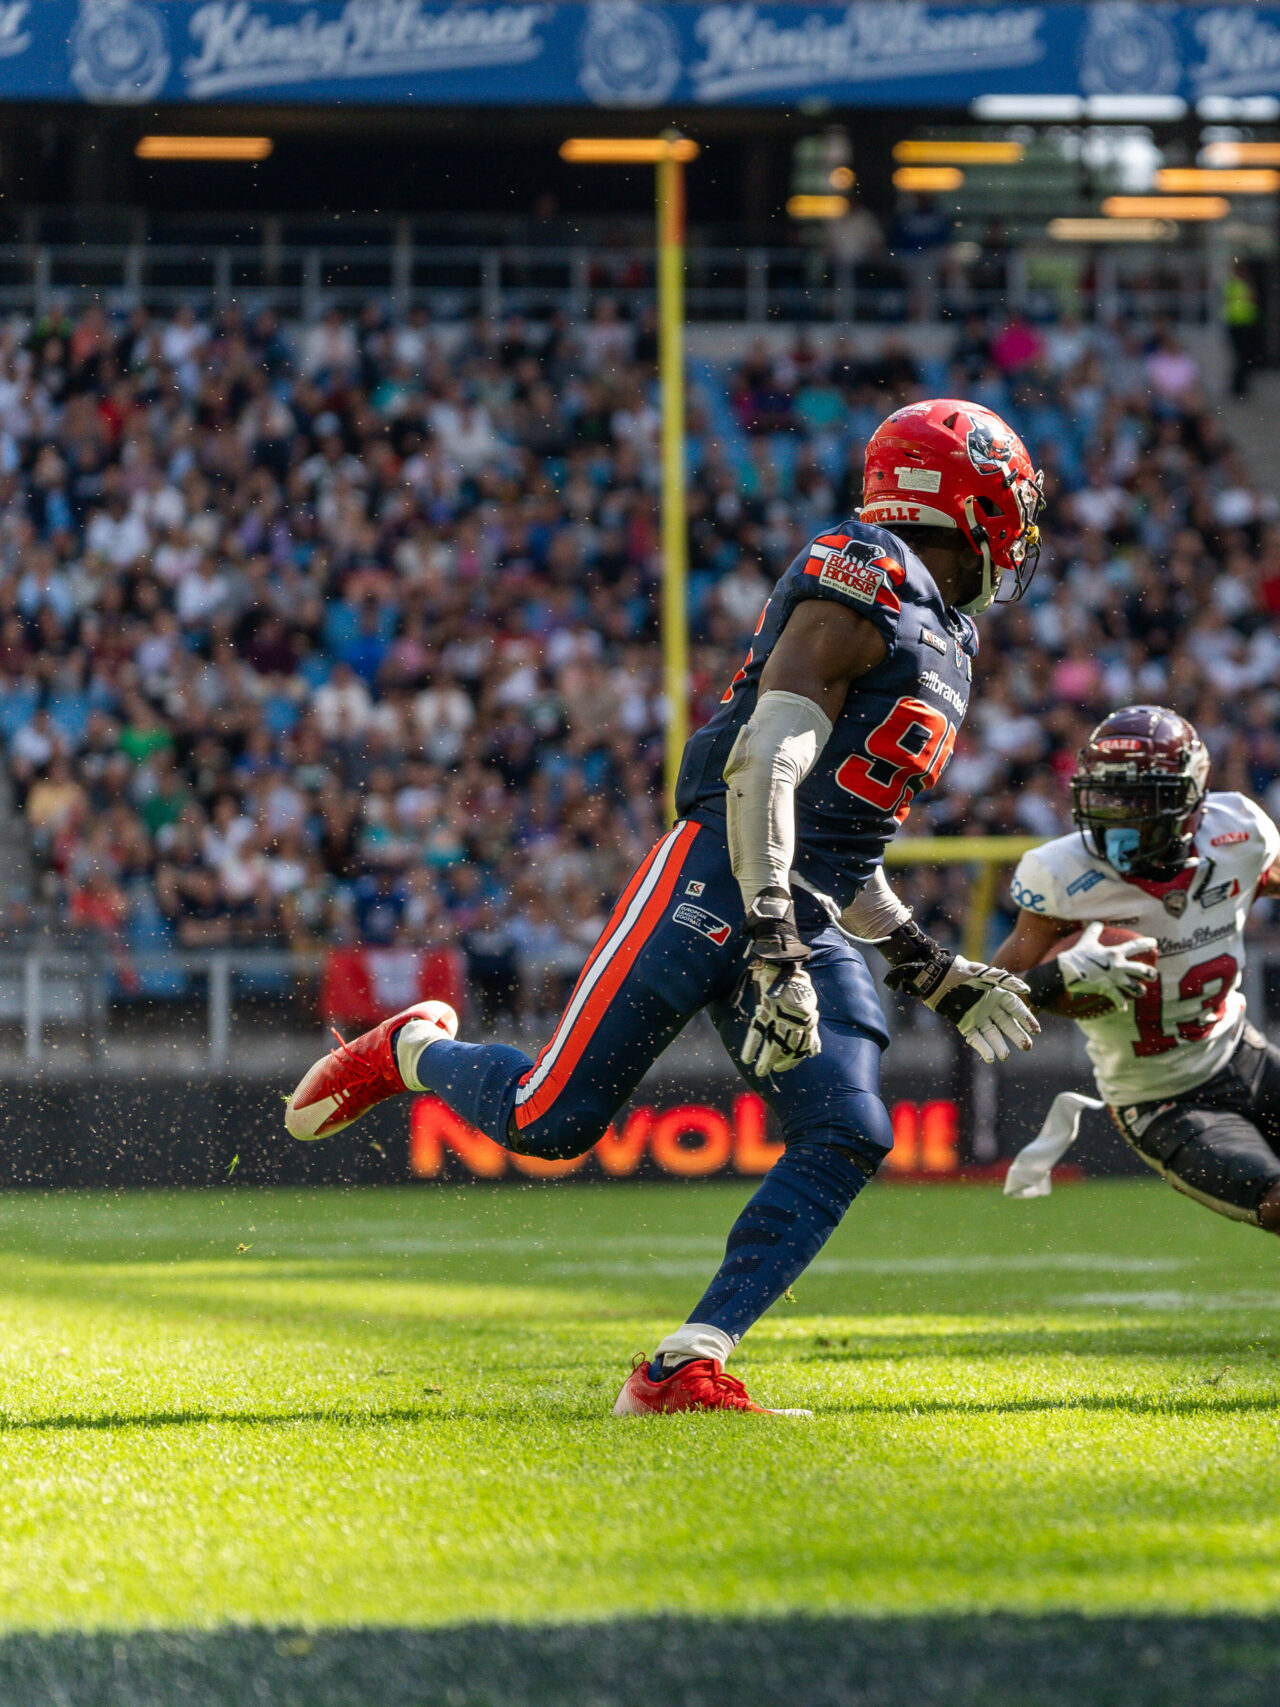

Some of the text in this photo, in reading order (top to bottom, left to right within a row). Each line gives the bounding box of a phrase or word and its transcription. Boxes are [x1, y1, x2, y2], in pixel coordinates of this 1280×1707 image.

[860, 507, 920, 524] ORELLE
[824, 565, 876, 596] HOUSE
[827, 554, 880, 585] BLOCK
[1132, 953, 1237, 1058] 13
